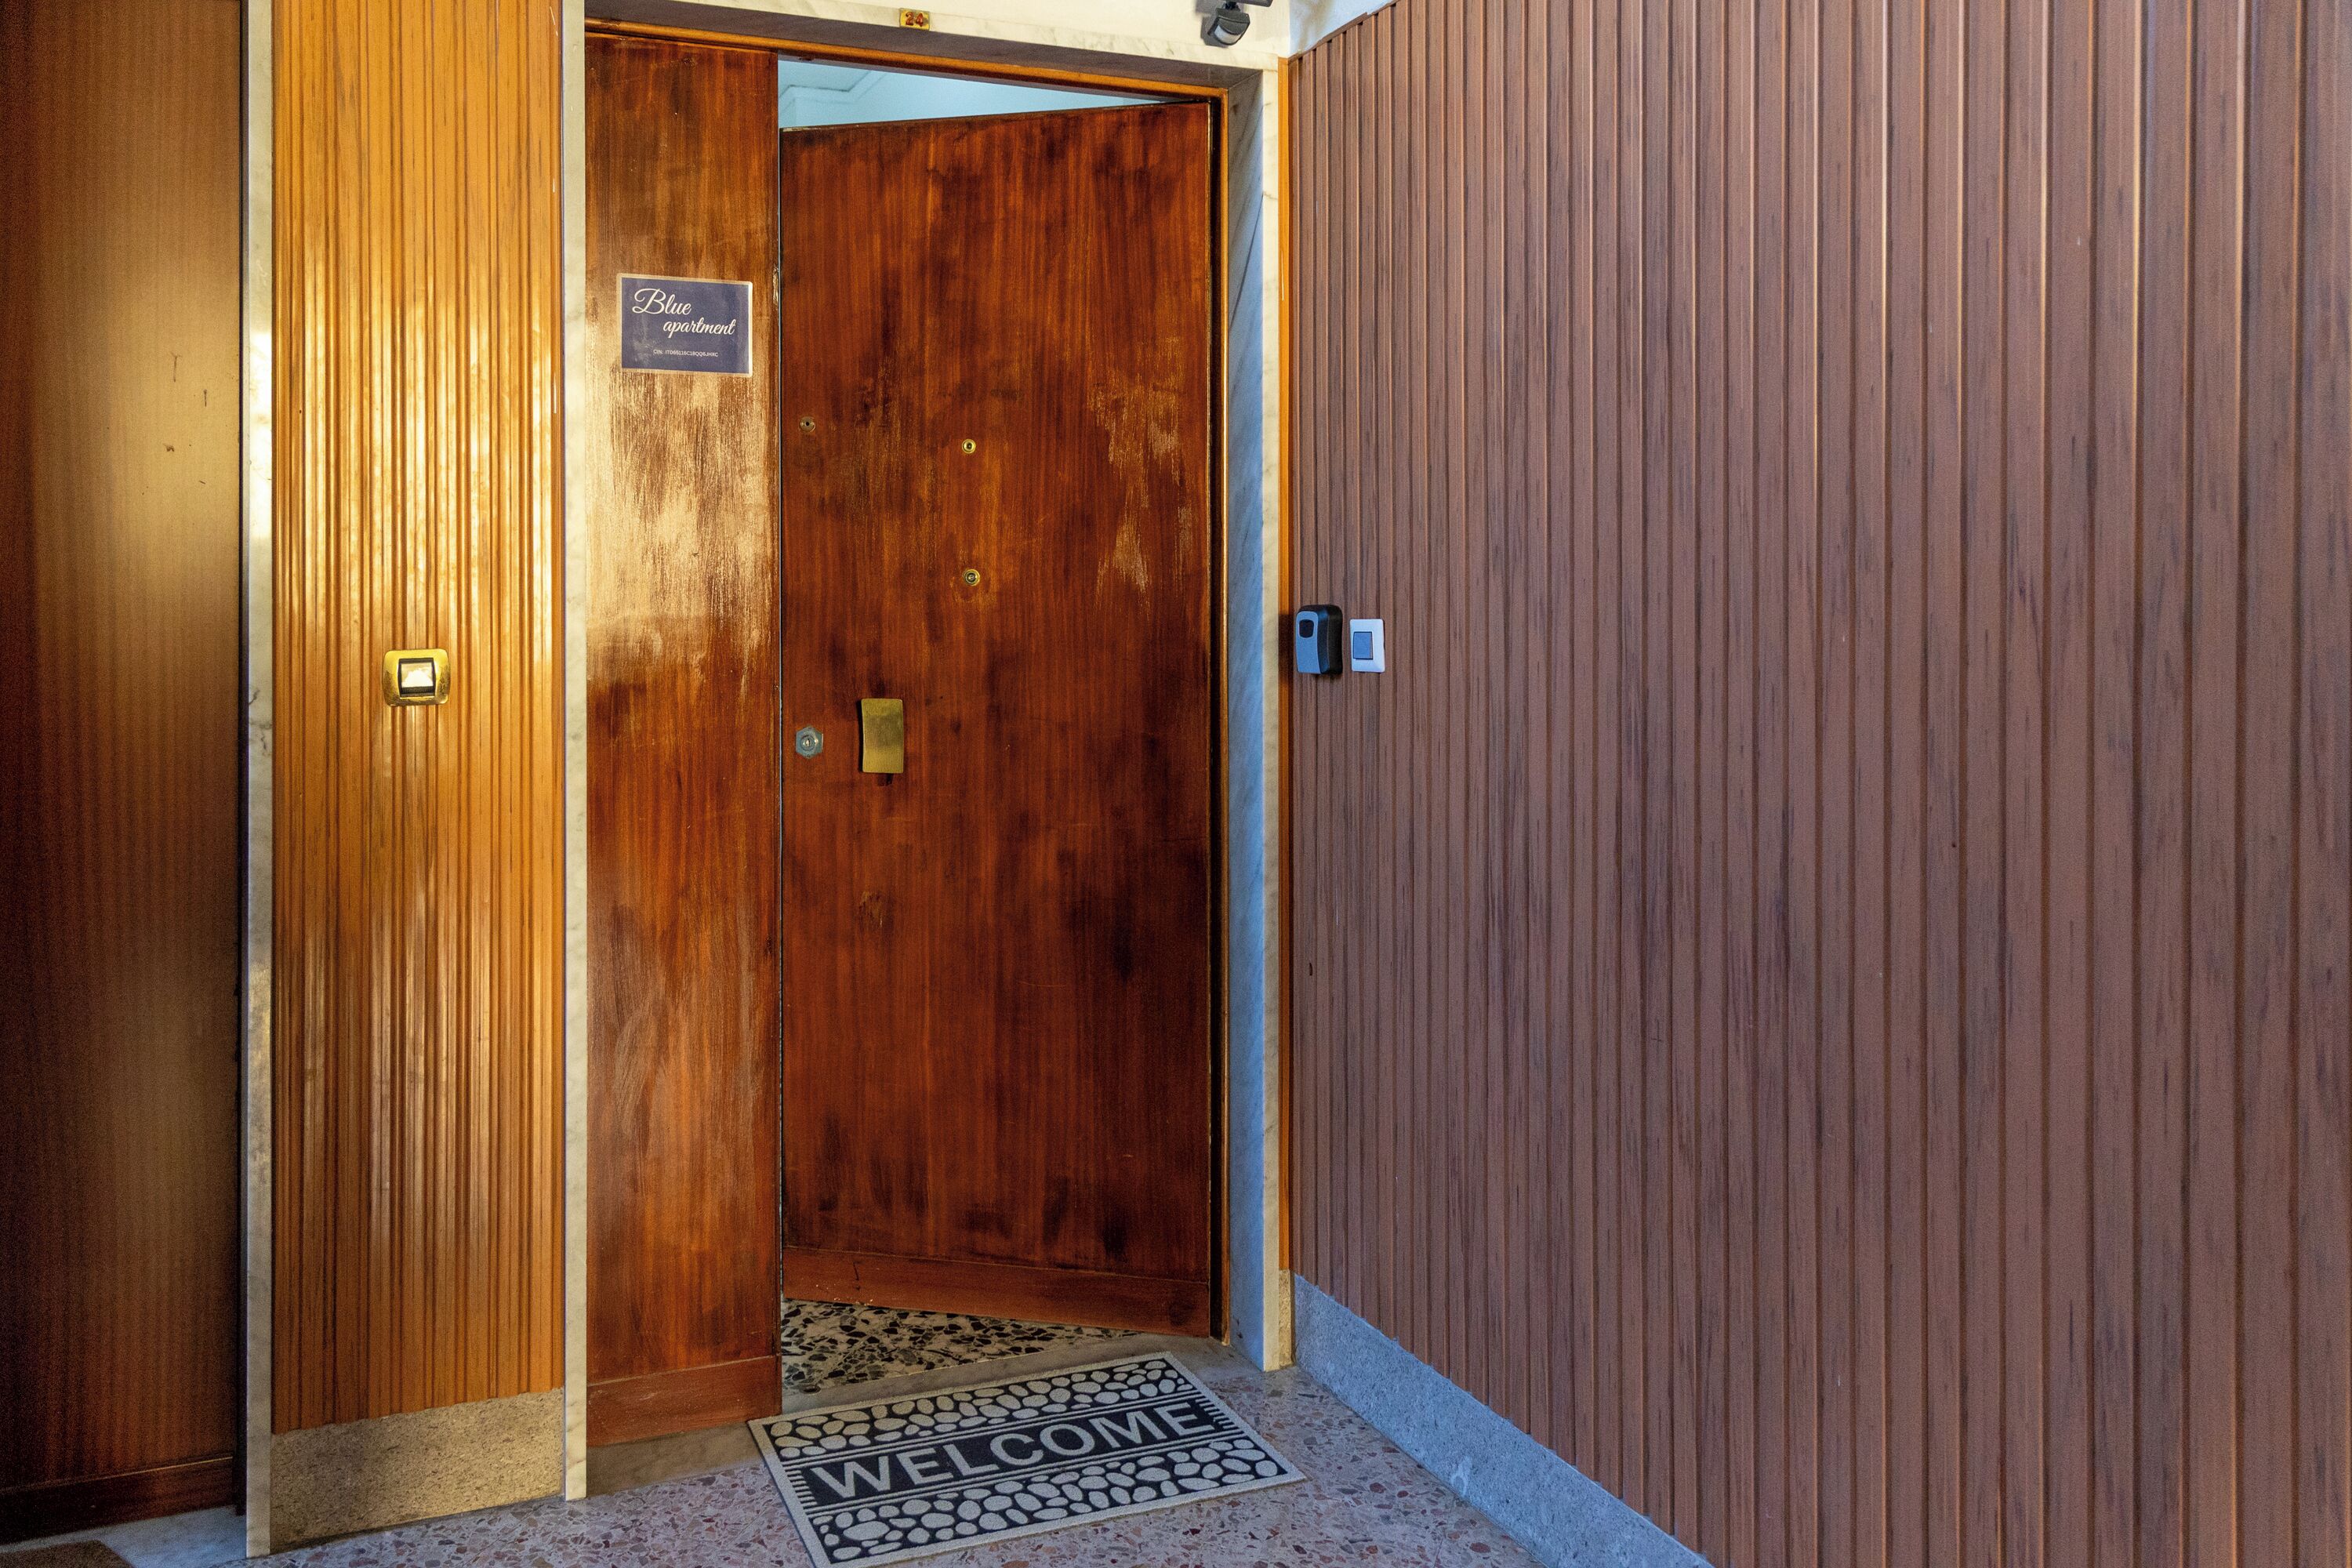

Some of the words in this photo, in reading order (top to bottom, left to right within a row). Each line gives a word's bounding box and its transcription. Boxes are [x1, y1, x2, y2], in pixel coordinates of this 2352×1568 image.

[906, 11, 924, 27] 24
[632, 288, 691, 315] Blue
[663, 317, 736, 339] apartment
[811, 1402, 1214, 1499] WELCOME
